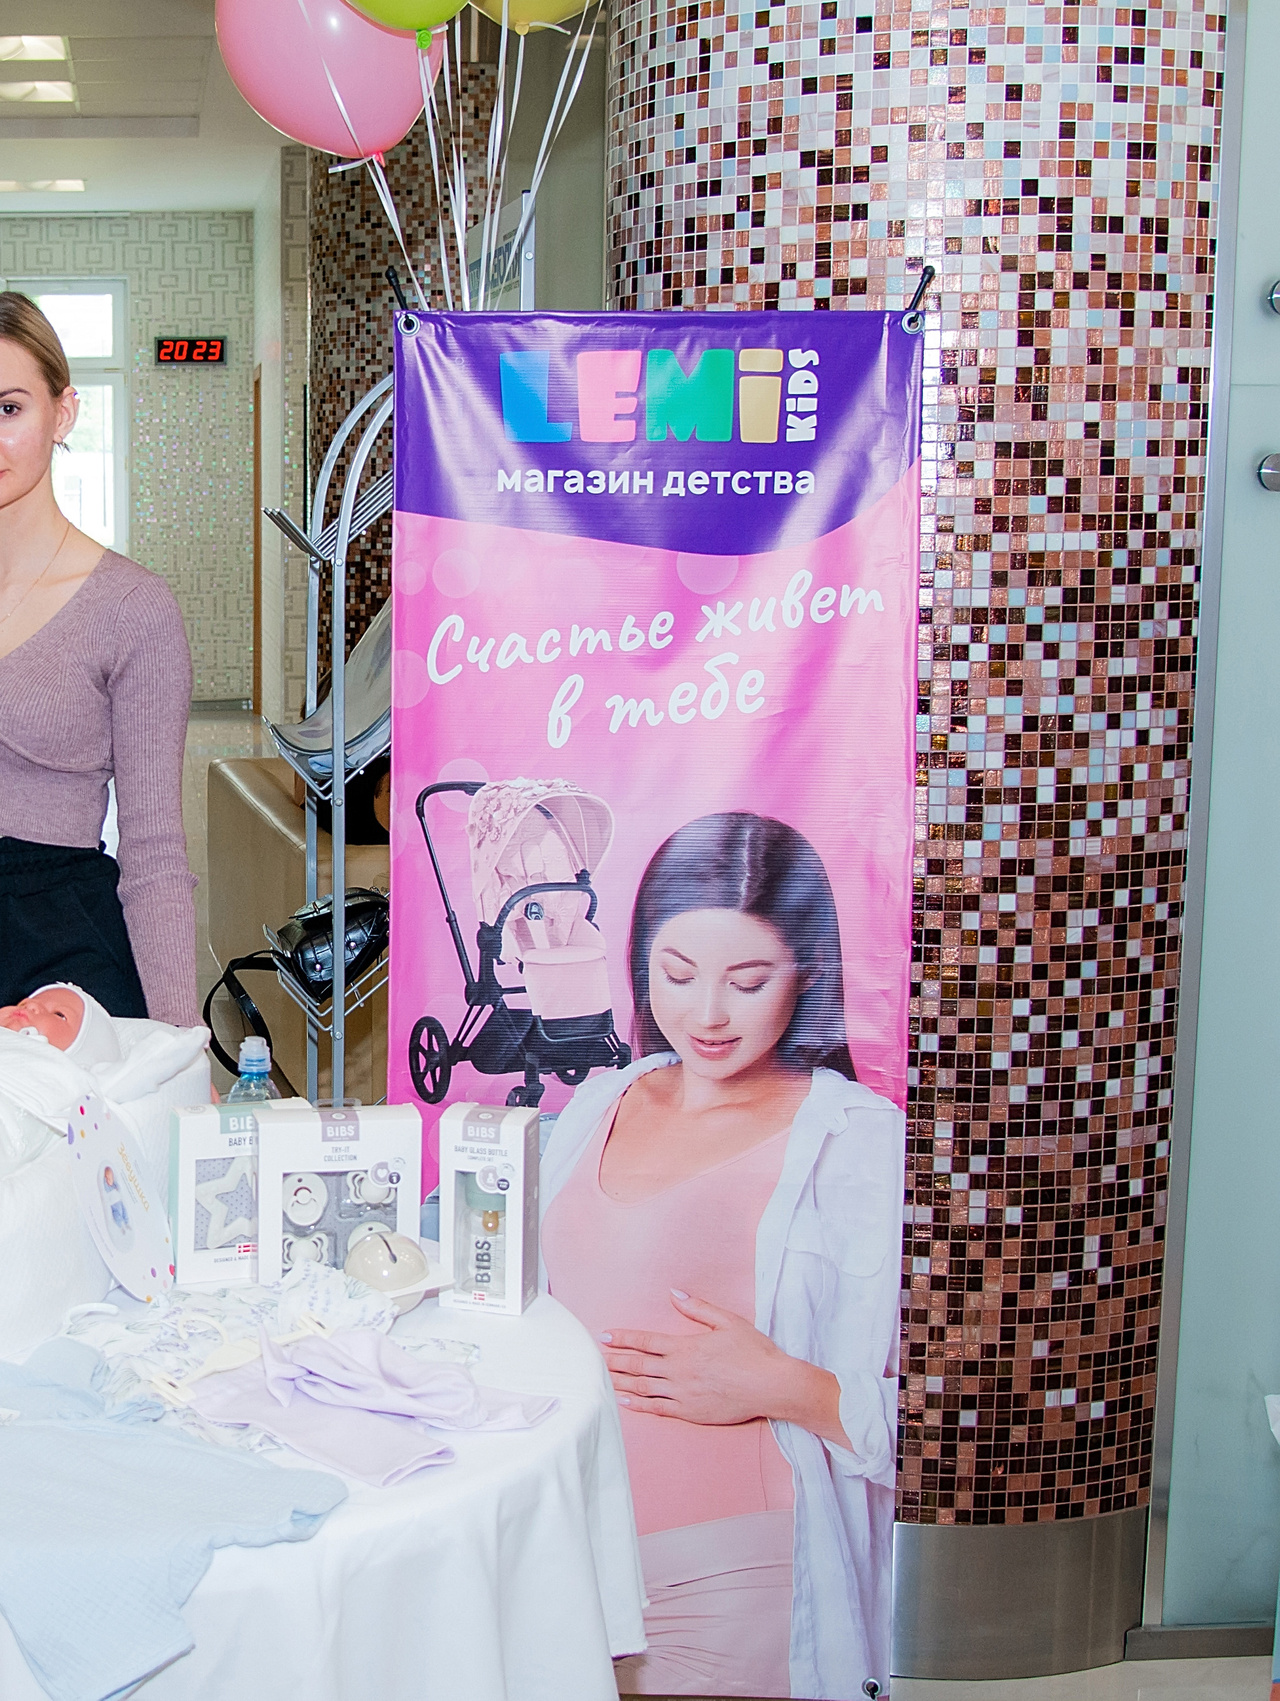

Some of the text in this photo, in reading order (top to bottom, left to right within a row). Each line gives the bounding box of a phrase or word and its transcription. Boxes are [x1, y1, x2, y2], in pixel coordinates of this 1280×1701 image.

[160, 341, 221, 360] 20 23
[497, 469, 815, 496] магазин детства
[427, 569, 885, 685] Счастье живет
[547, 652, 765, 748] в тебе
[229, 1116, 254, 1130] BIB
[326, 1125, 355, 1137] BIBS
[467, 1125, 495, 1138] BIBS
[229, 1137, 246, 1146] BABY
[324, 1154, 357, 1162] COLLECTION
[469, 1147, 487, 1155] GLASS
[488, 1149, 508, 1157] BOTTLE
[475, 1240, 491, 1283] BIBS
